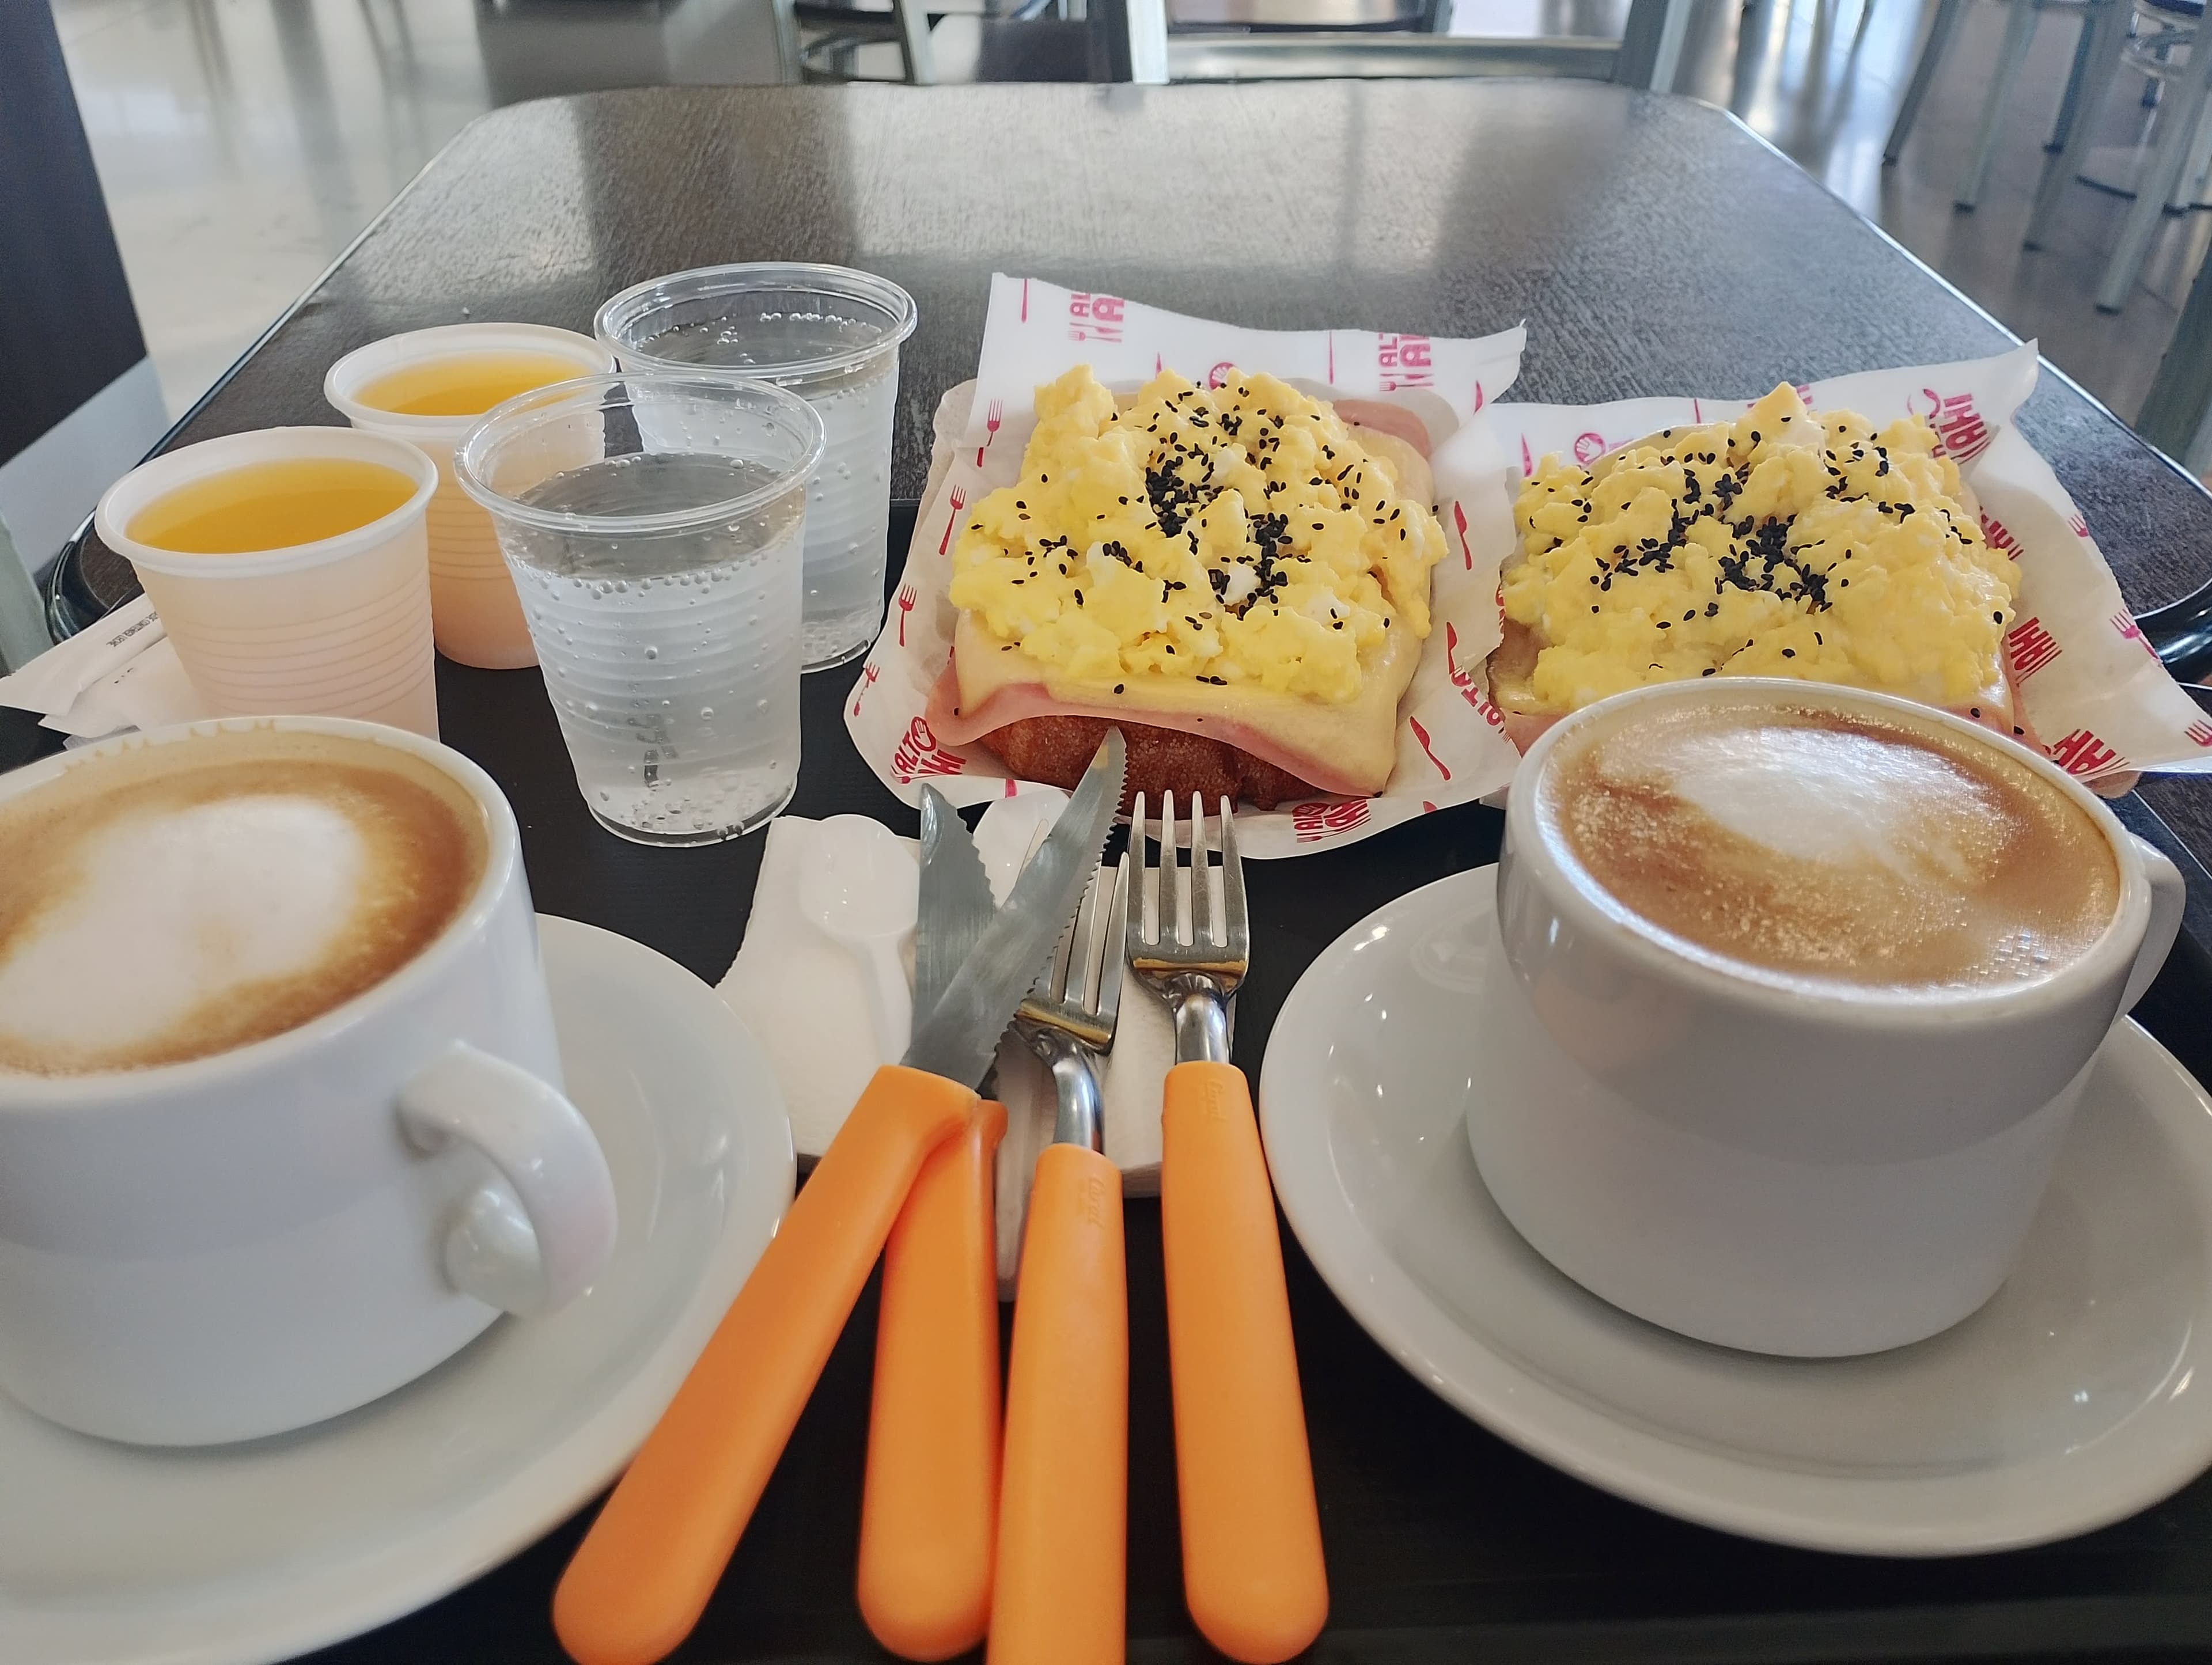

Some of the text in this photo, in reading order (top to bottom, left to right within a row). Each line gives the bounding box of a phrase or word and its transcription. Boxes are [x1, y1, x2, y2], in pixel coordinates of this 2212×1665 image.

[1940, 393, 1988, 450] AHI
[2009, 617, 2056, 670] AHI
[895, 716, 937, 773] ALTO
